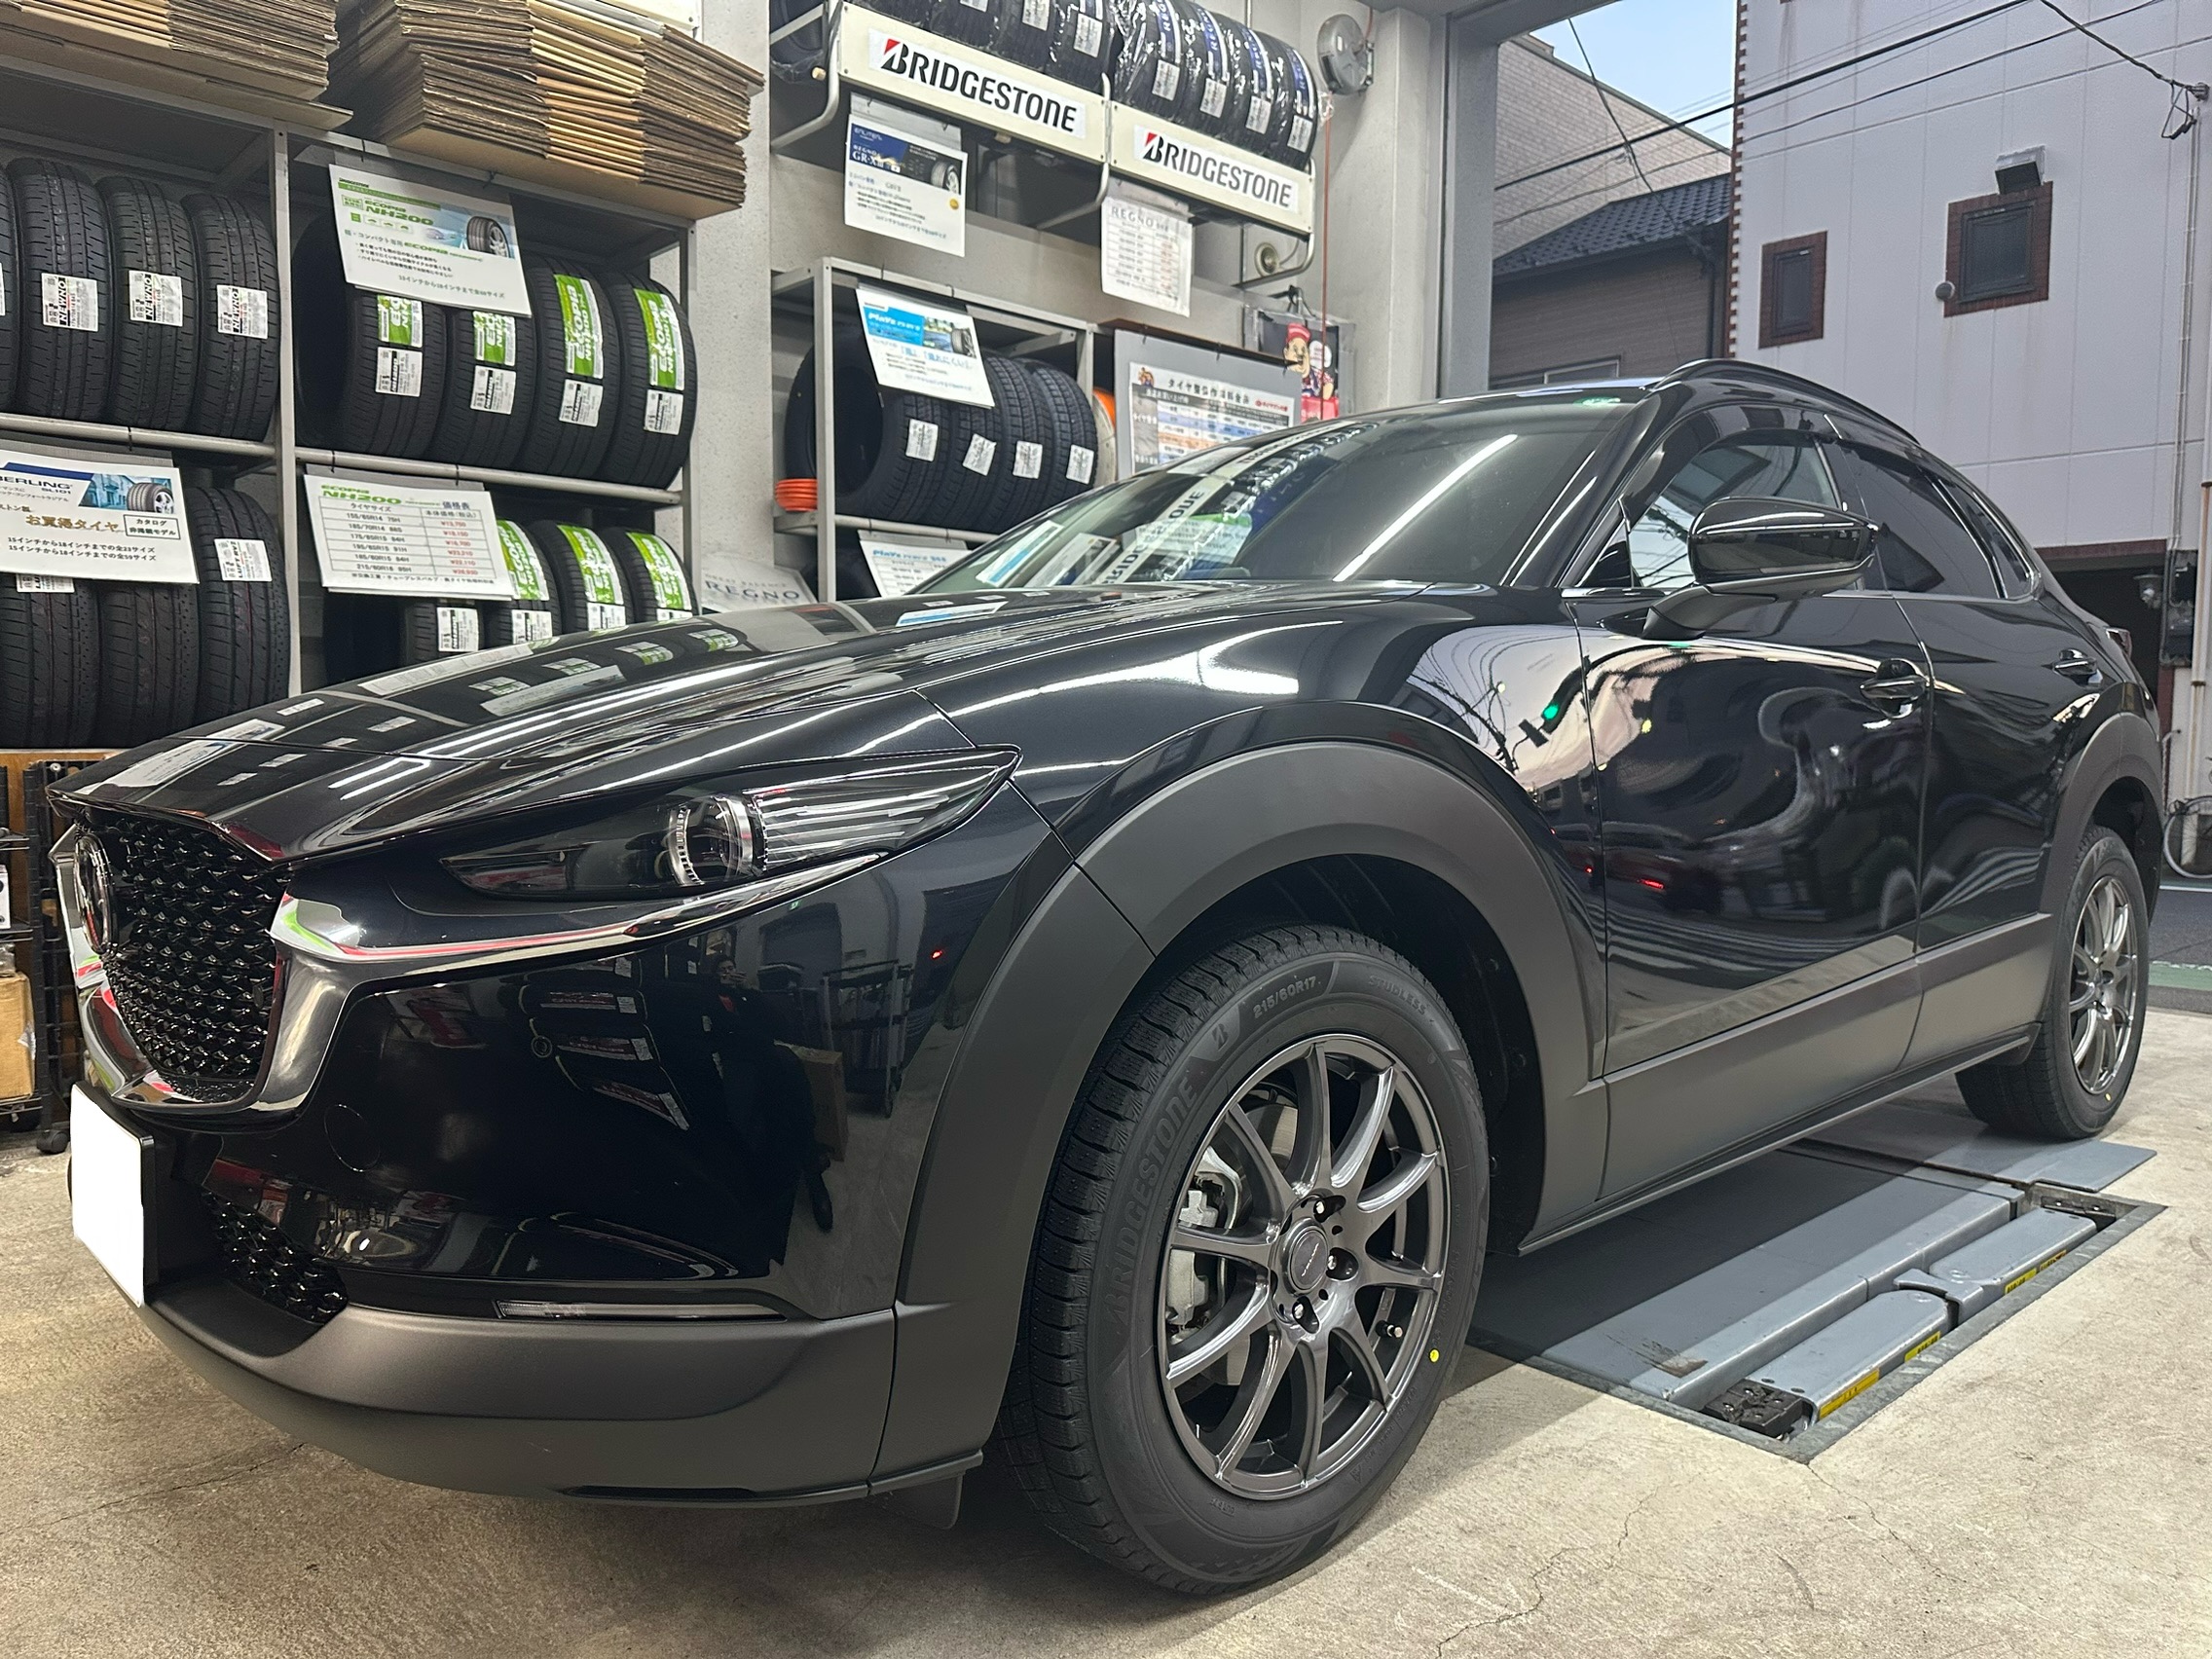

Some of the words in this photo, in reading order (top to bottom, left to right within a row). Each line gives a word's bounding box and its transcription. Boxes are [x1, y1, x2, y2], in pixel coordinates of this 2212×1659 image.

[881, 38, 1077, 132] BRIDGESTONE
[1143, 131, 1292, 207] BRIDGESTONE
[365, 205, 434, 226] NH200
[58, 279, 67, 322] NEWNO
[144, 276, 153, 316] NEWNO
[0, 476, 72, 490] ERLING
[323, 490, 402, 504] NH200
[350, 502, 391, 512] タイヤサイズ
[442, 500, 471, 510] 価格表
[25, 514, 119, 533] お買得タイヤ
[129, 527, 176, 536] 非掲載モデル
[135, 518, 167, 527] カタログ
[704, 579, 800, 601] REGNO
[1252, 975, 1319, 1018] 215/60R17
[1368, 974, 1427, 1015] STUDLESS
[1104, 1075, 1198, 1326] BRIDGESTONE
